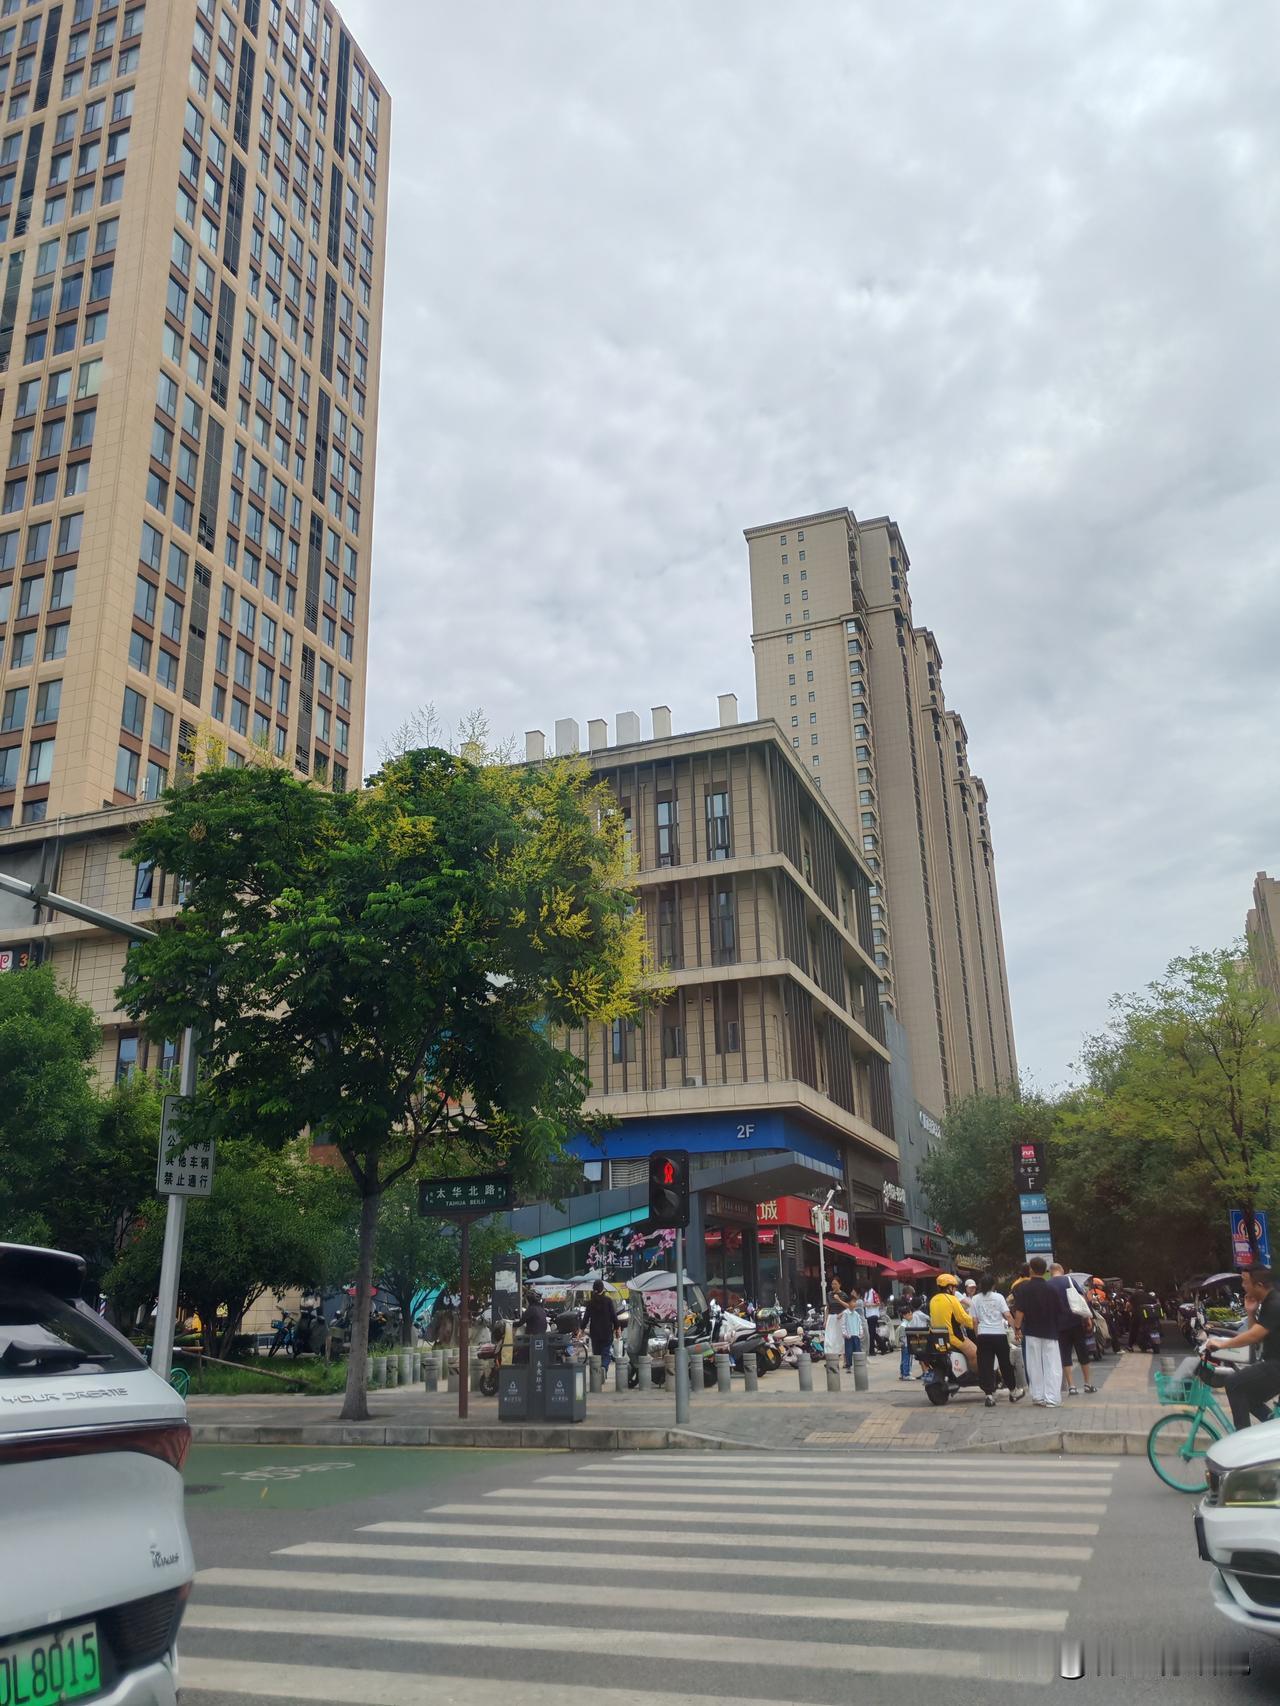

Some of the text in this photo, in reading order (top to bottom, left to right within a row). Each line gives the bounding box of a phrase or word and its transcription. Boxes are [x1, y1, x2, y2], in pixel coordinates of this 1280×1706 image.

[736, 1124, 755, 1139] 2F
[167, 1135, 210, 1152] 公专用
[164, 1171, 208, 1188] 禁止通行
[1028, 1178, 1035, 1189] F
[436, 1184, 496, 1199] 太华北路
[756, 1201, 779, 1221] 城
[1, 1393, 60, 1404] YOUR
